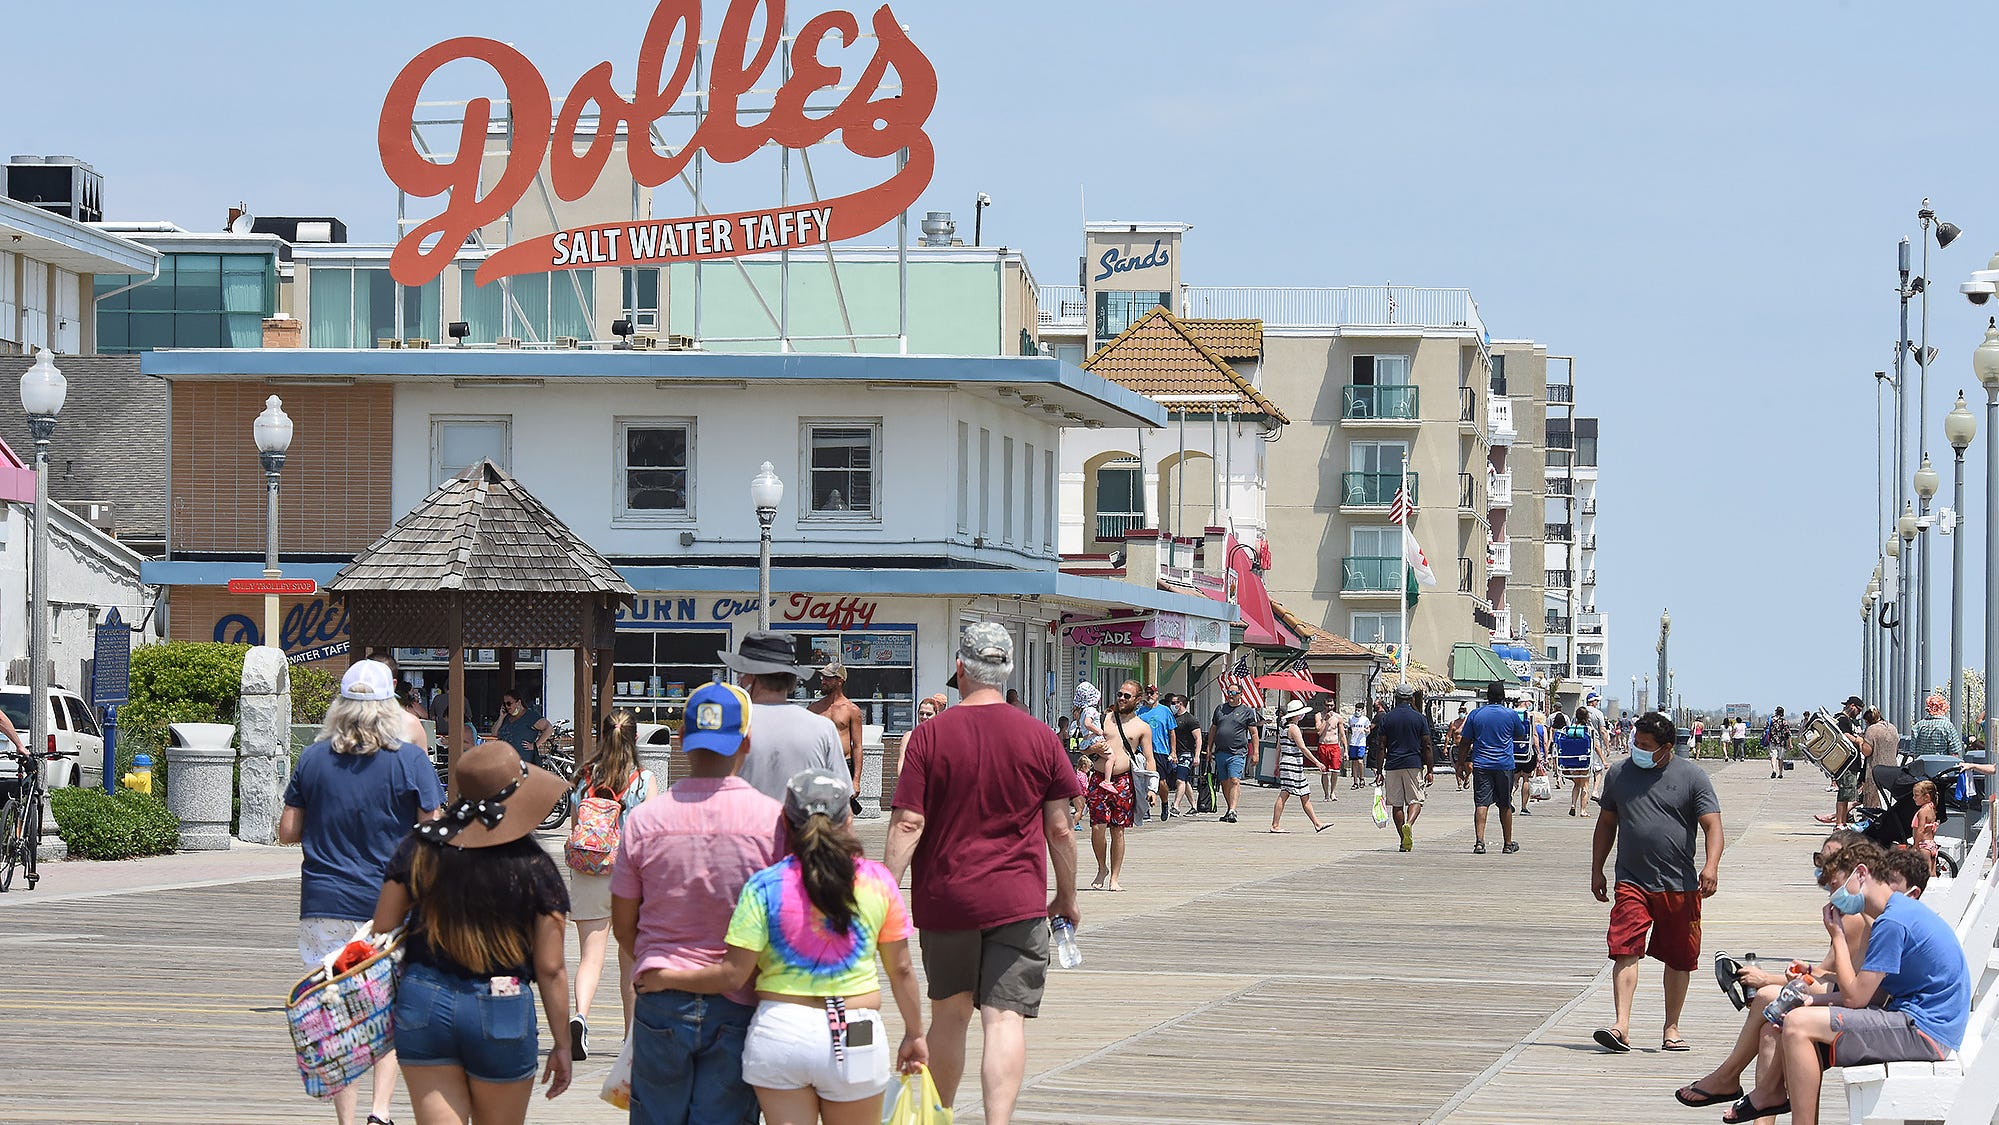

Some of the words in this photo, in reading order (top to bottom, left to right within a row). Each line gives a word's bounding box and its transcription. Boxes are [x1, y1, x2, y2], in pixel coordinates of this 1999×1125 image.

[552, 228, 621, 266] SALT
[627, 219, 734, 260] WATER
[739, 207, 833, 251] TAFFY
[1094, 239, 1169, 282] Sands
[256, 582, 291, 590] TROLLEY
[292, 582, 312, 590] STOP
[784, 592, 878, 632] Taffy
[322, 641, 351, 657] TAFF
